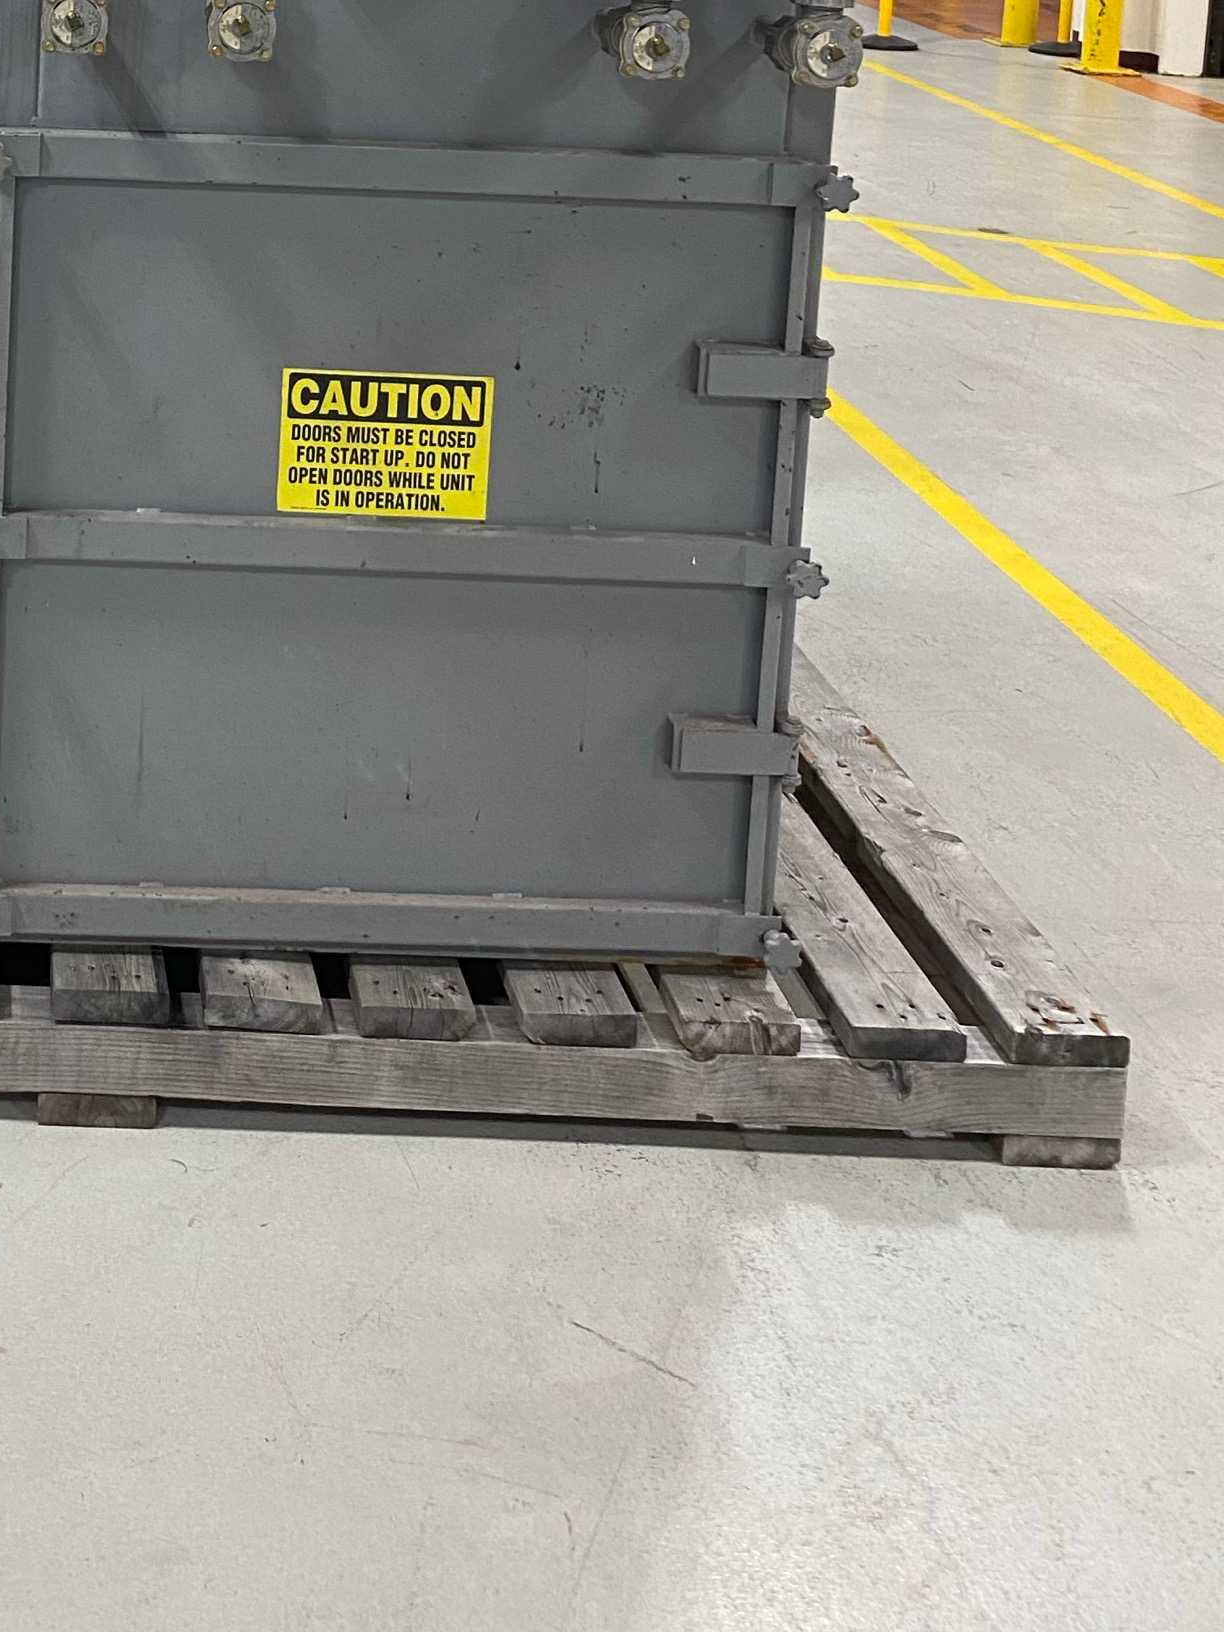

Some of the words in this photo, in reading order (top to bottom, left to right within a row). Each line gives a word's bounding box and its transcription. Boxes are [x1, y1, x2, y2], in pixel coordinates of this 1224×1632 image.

[291, 378, 482, 421] CAUTION
[292, 424, 342, 443] DOORS
[347, 426, 390, 445] MUST
[395, 429, 414, 446] BE
[419, 430, 476, 449] CLOSED
[296, 446, 326, 463] FOR
[331, 447, 379, 465] START
[416, 452, 435, 468] DO
[441, 453, 471, 470] NOT
[289, 467, 327, 485] OPEN
[333, 469, 383, 487] DOORS
[388, 471, 435, 490] WHILE
[440, 474, 476, 491] UNIT
[316, 489, 330, 506] IS
[335, 490, 350, 508] IN
[355, 491, 445, 512] OPERATION.
